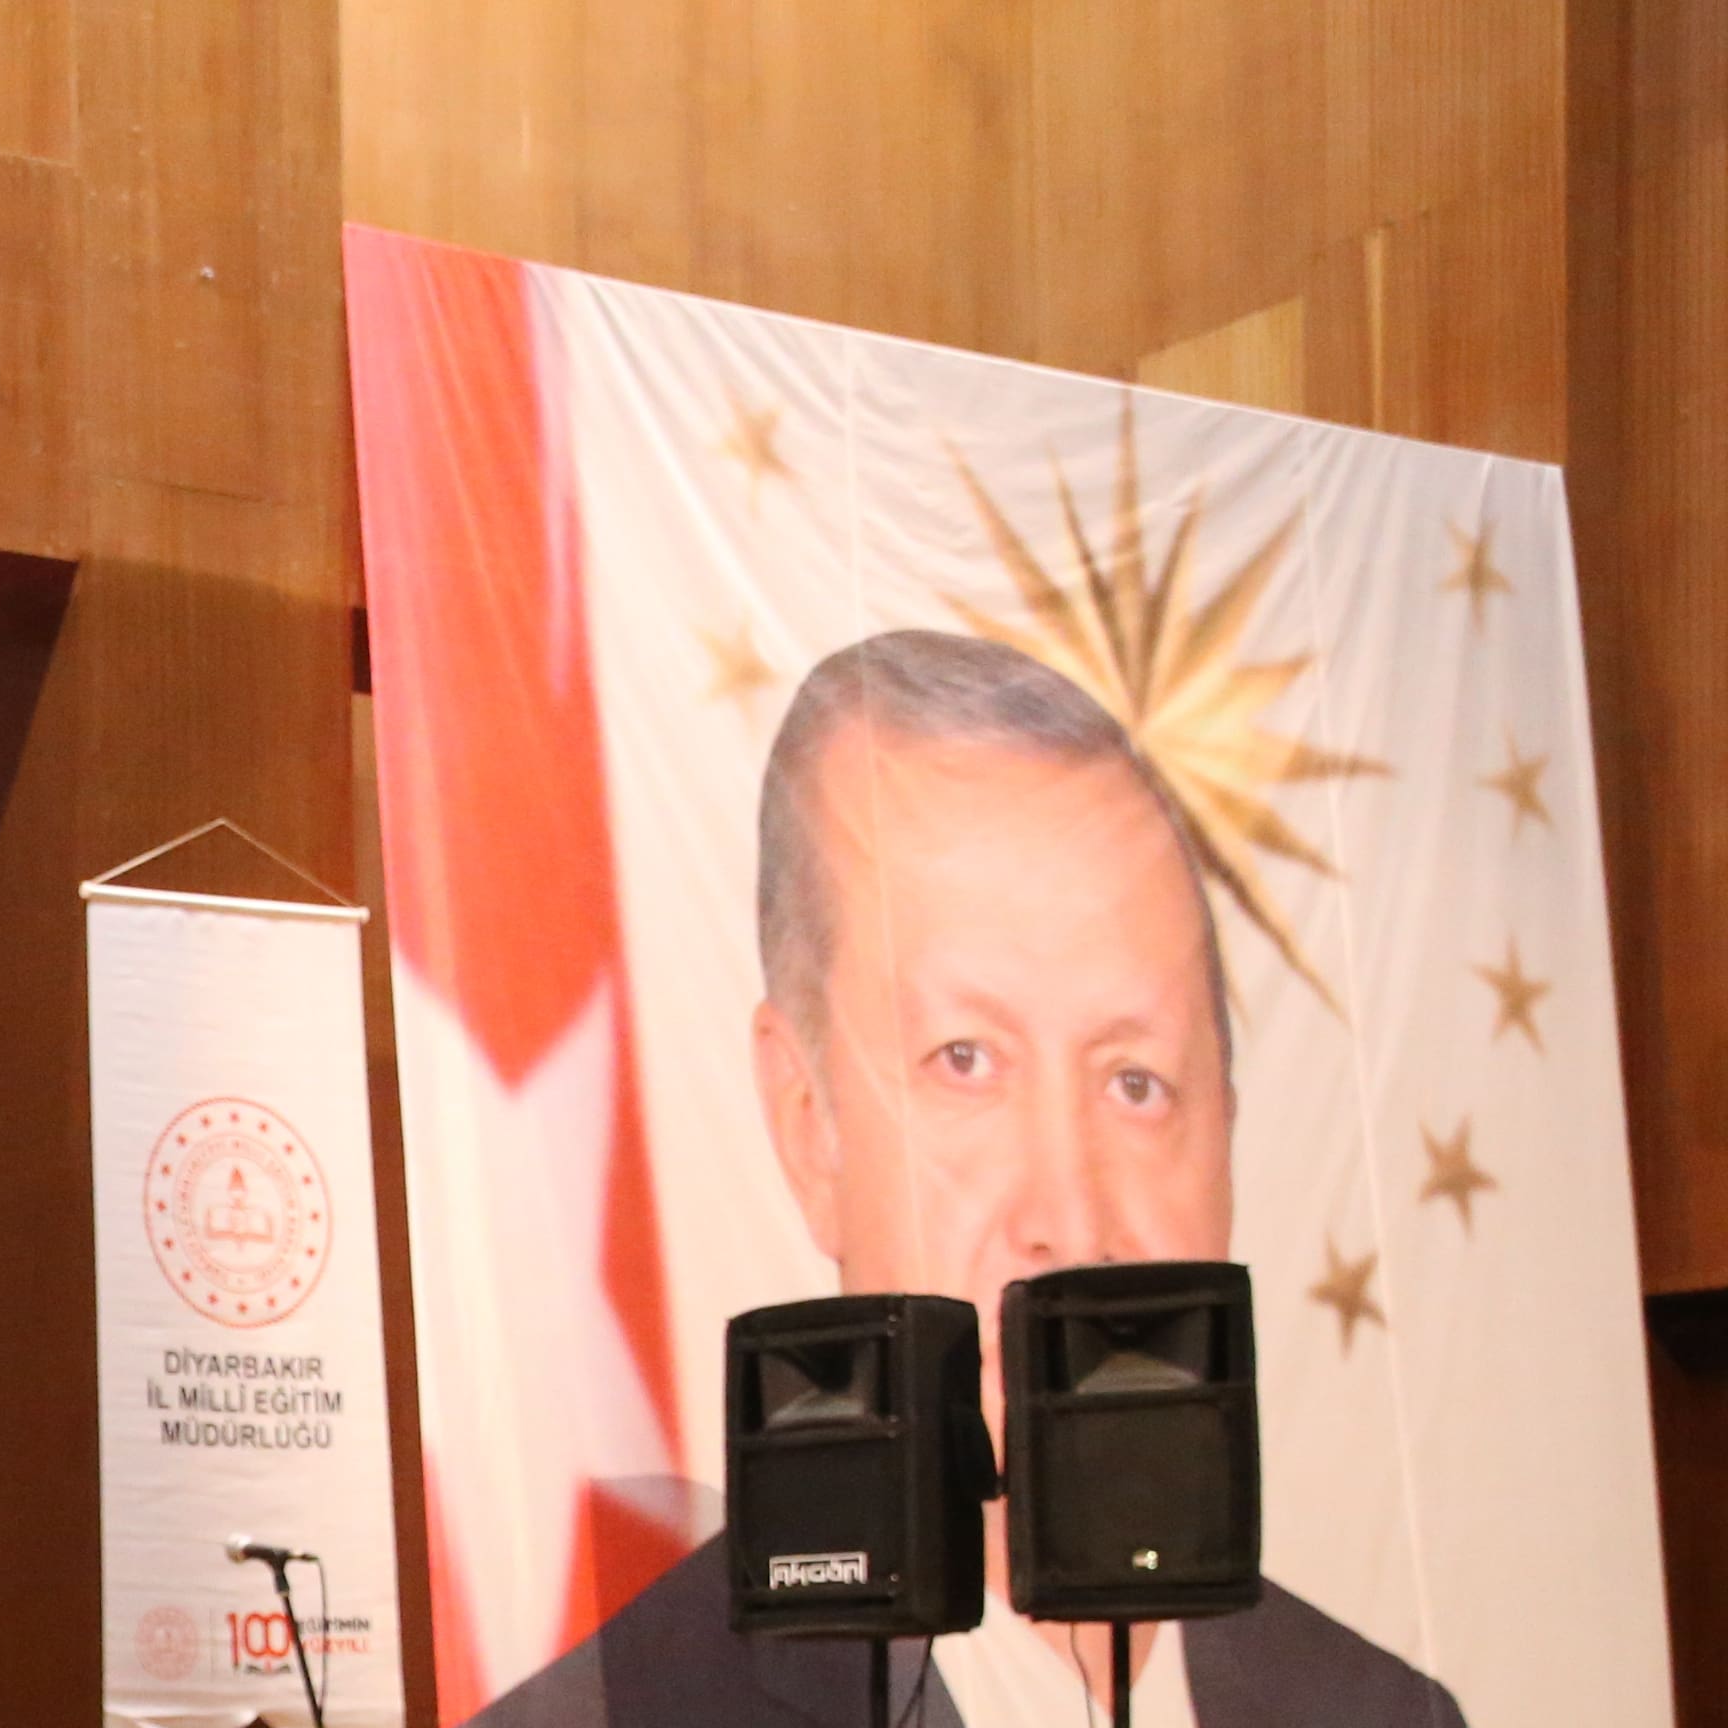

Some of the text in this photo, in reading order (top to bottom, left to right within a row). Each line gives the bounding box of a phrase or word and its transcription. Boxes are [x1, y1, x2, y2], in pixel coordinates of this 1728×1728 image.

[164, 1347, 324, 1380] DİYARBAKIR
[146, 1379, 342, 1415] İL MİLLİ EĞİTİM
[161, 1415, 332, 1449] MÜDÜRLÜĞÜ
[227, 1612, 293, 1669] 100
